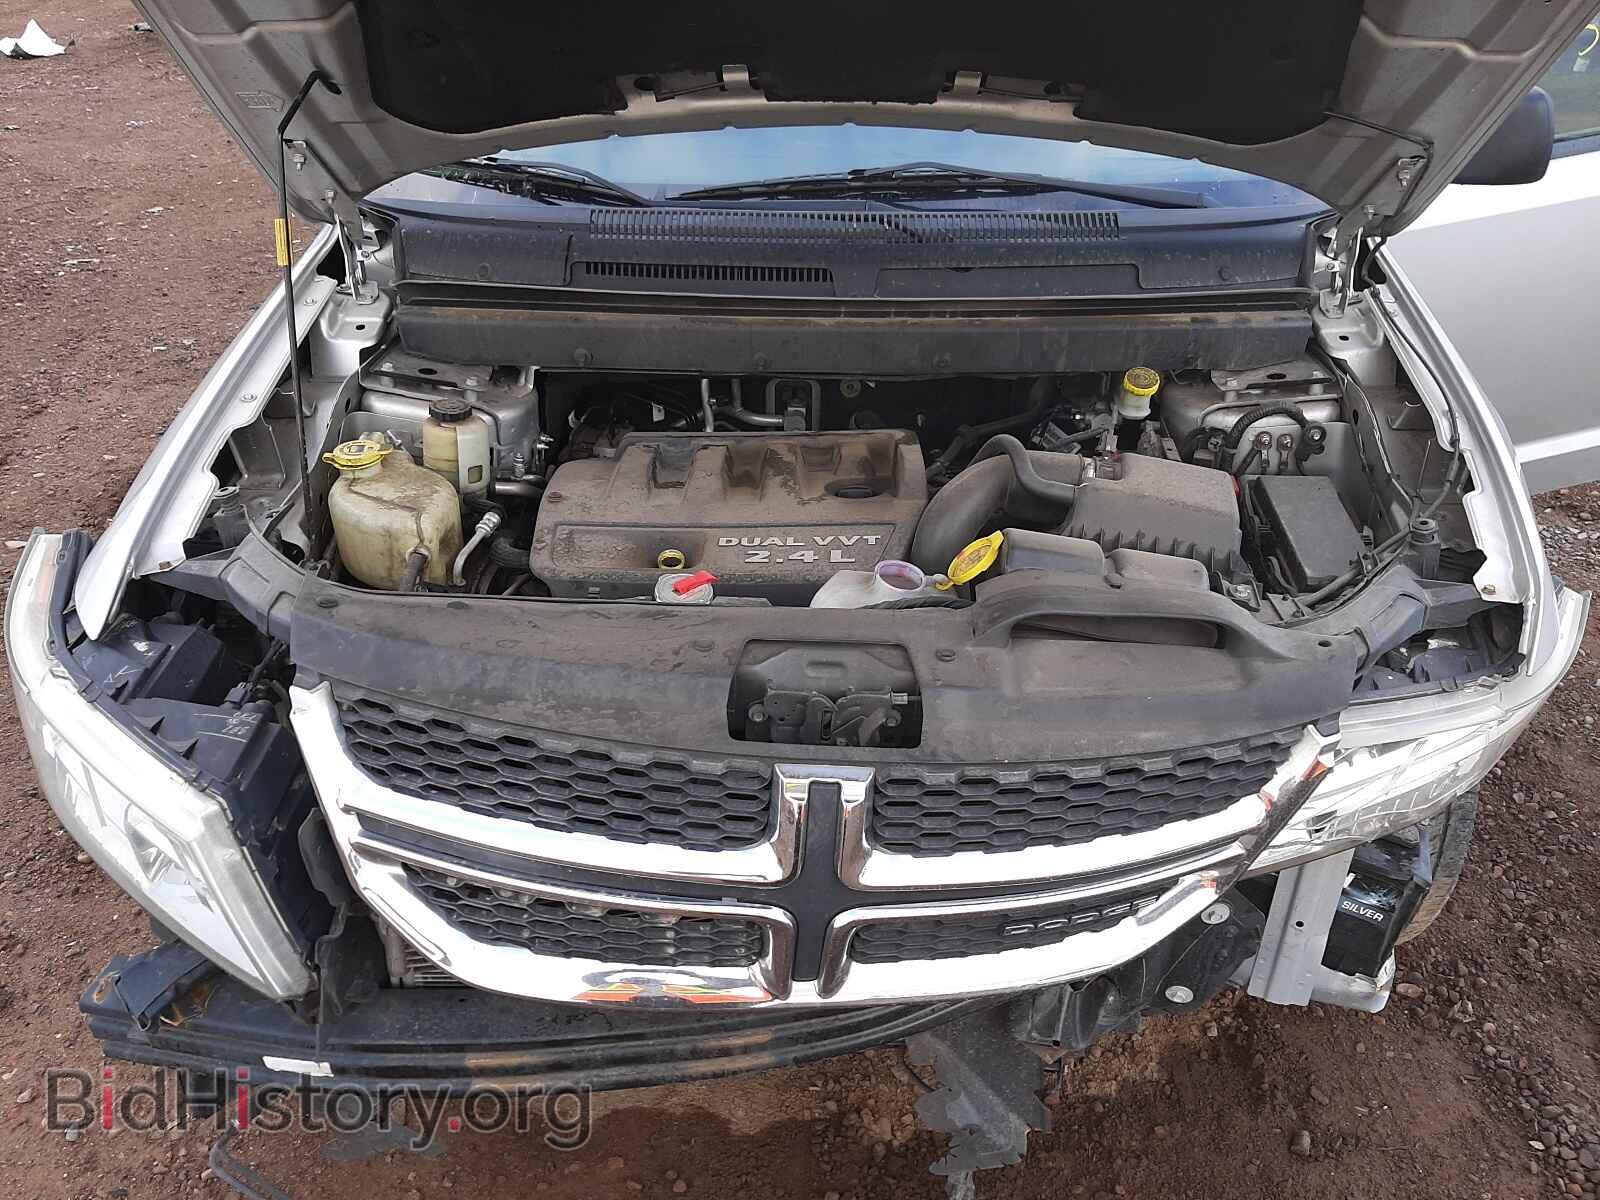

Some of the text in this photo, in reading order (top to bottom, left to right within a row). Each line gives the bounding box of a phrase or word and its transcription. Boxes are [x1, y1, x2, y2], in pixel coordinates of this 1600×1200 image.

[718, 535, 881, 546] DUAL VVT
[744, 550, 819, 563] 2.4
[1341, 900, 1384, 922] SILVER
